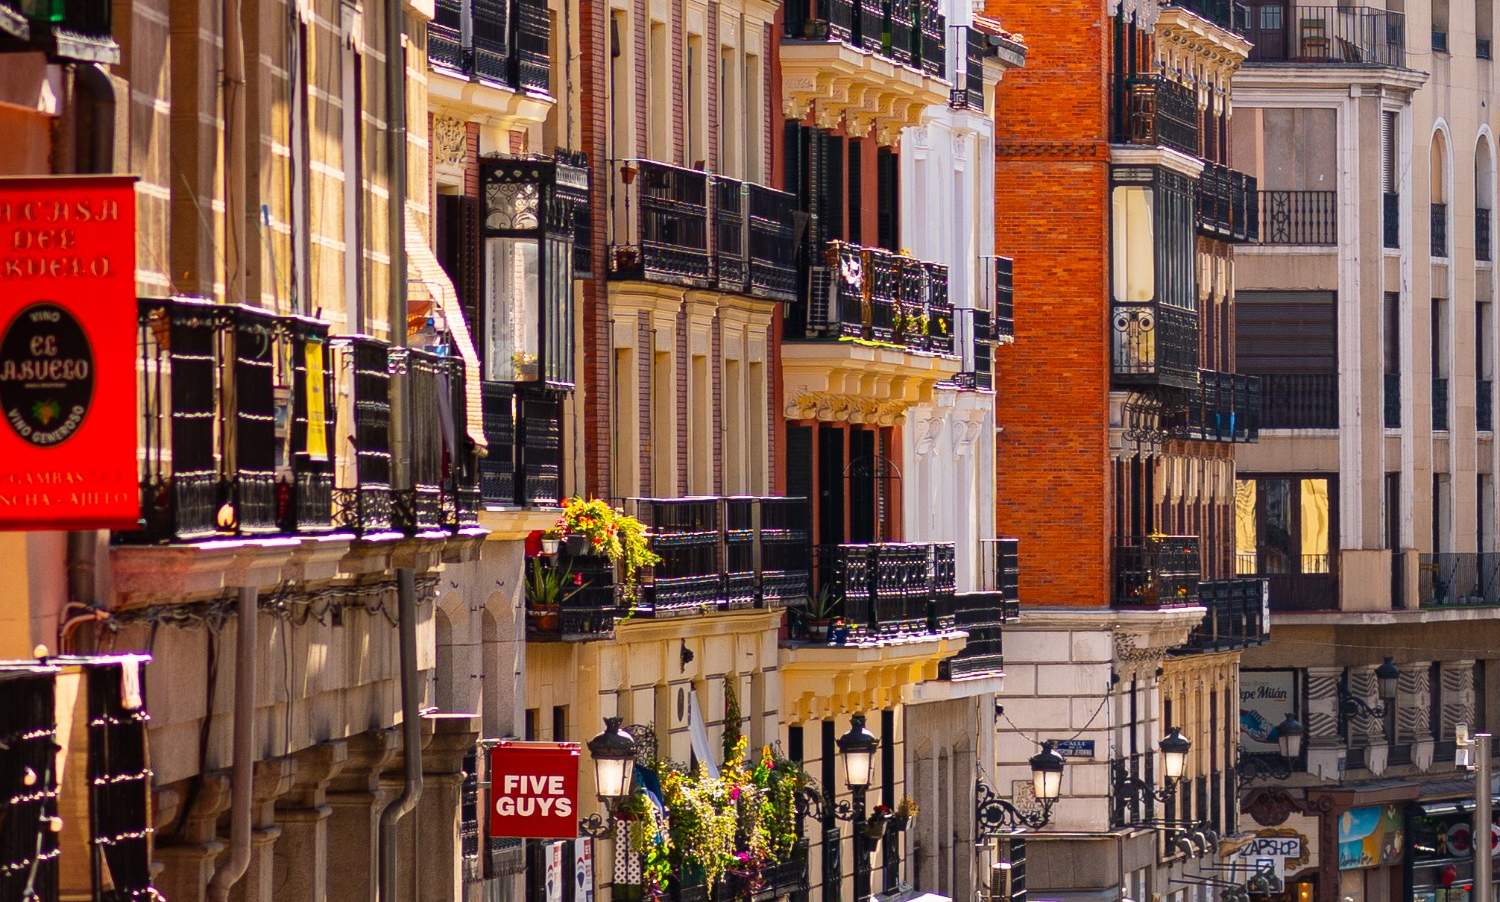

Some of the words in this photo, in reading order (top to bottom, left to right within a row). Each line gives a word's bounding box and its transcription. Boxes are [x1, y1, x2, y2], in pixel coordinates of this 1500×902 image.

[14, 229, 76, 249] DEL
[0, 257, 110, 277] BUELO
[29, 311, 61, 322] VINO
[30, 335, 58, 356] EL
[1, 359, 89, 380] ABUELO
[8, 408, 32, 437] VINO
[31, 405, 85, 443] GENEROSO
[504, 775, 565, 795] FIVE
[496, 796, 573, 818] GUYS
